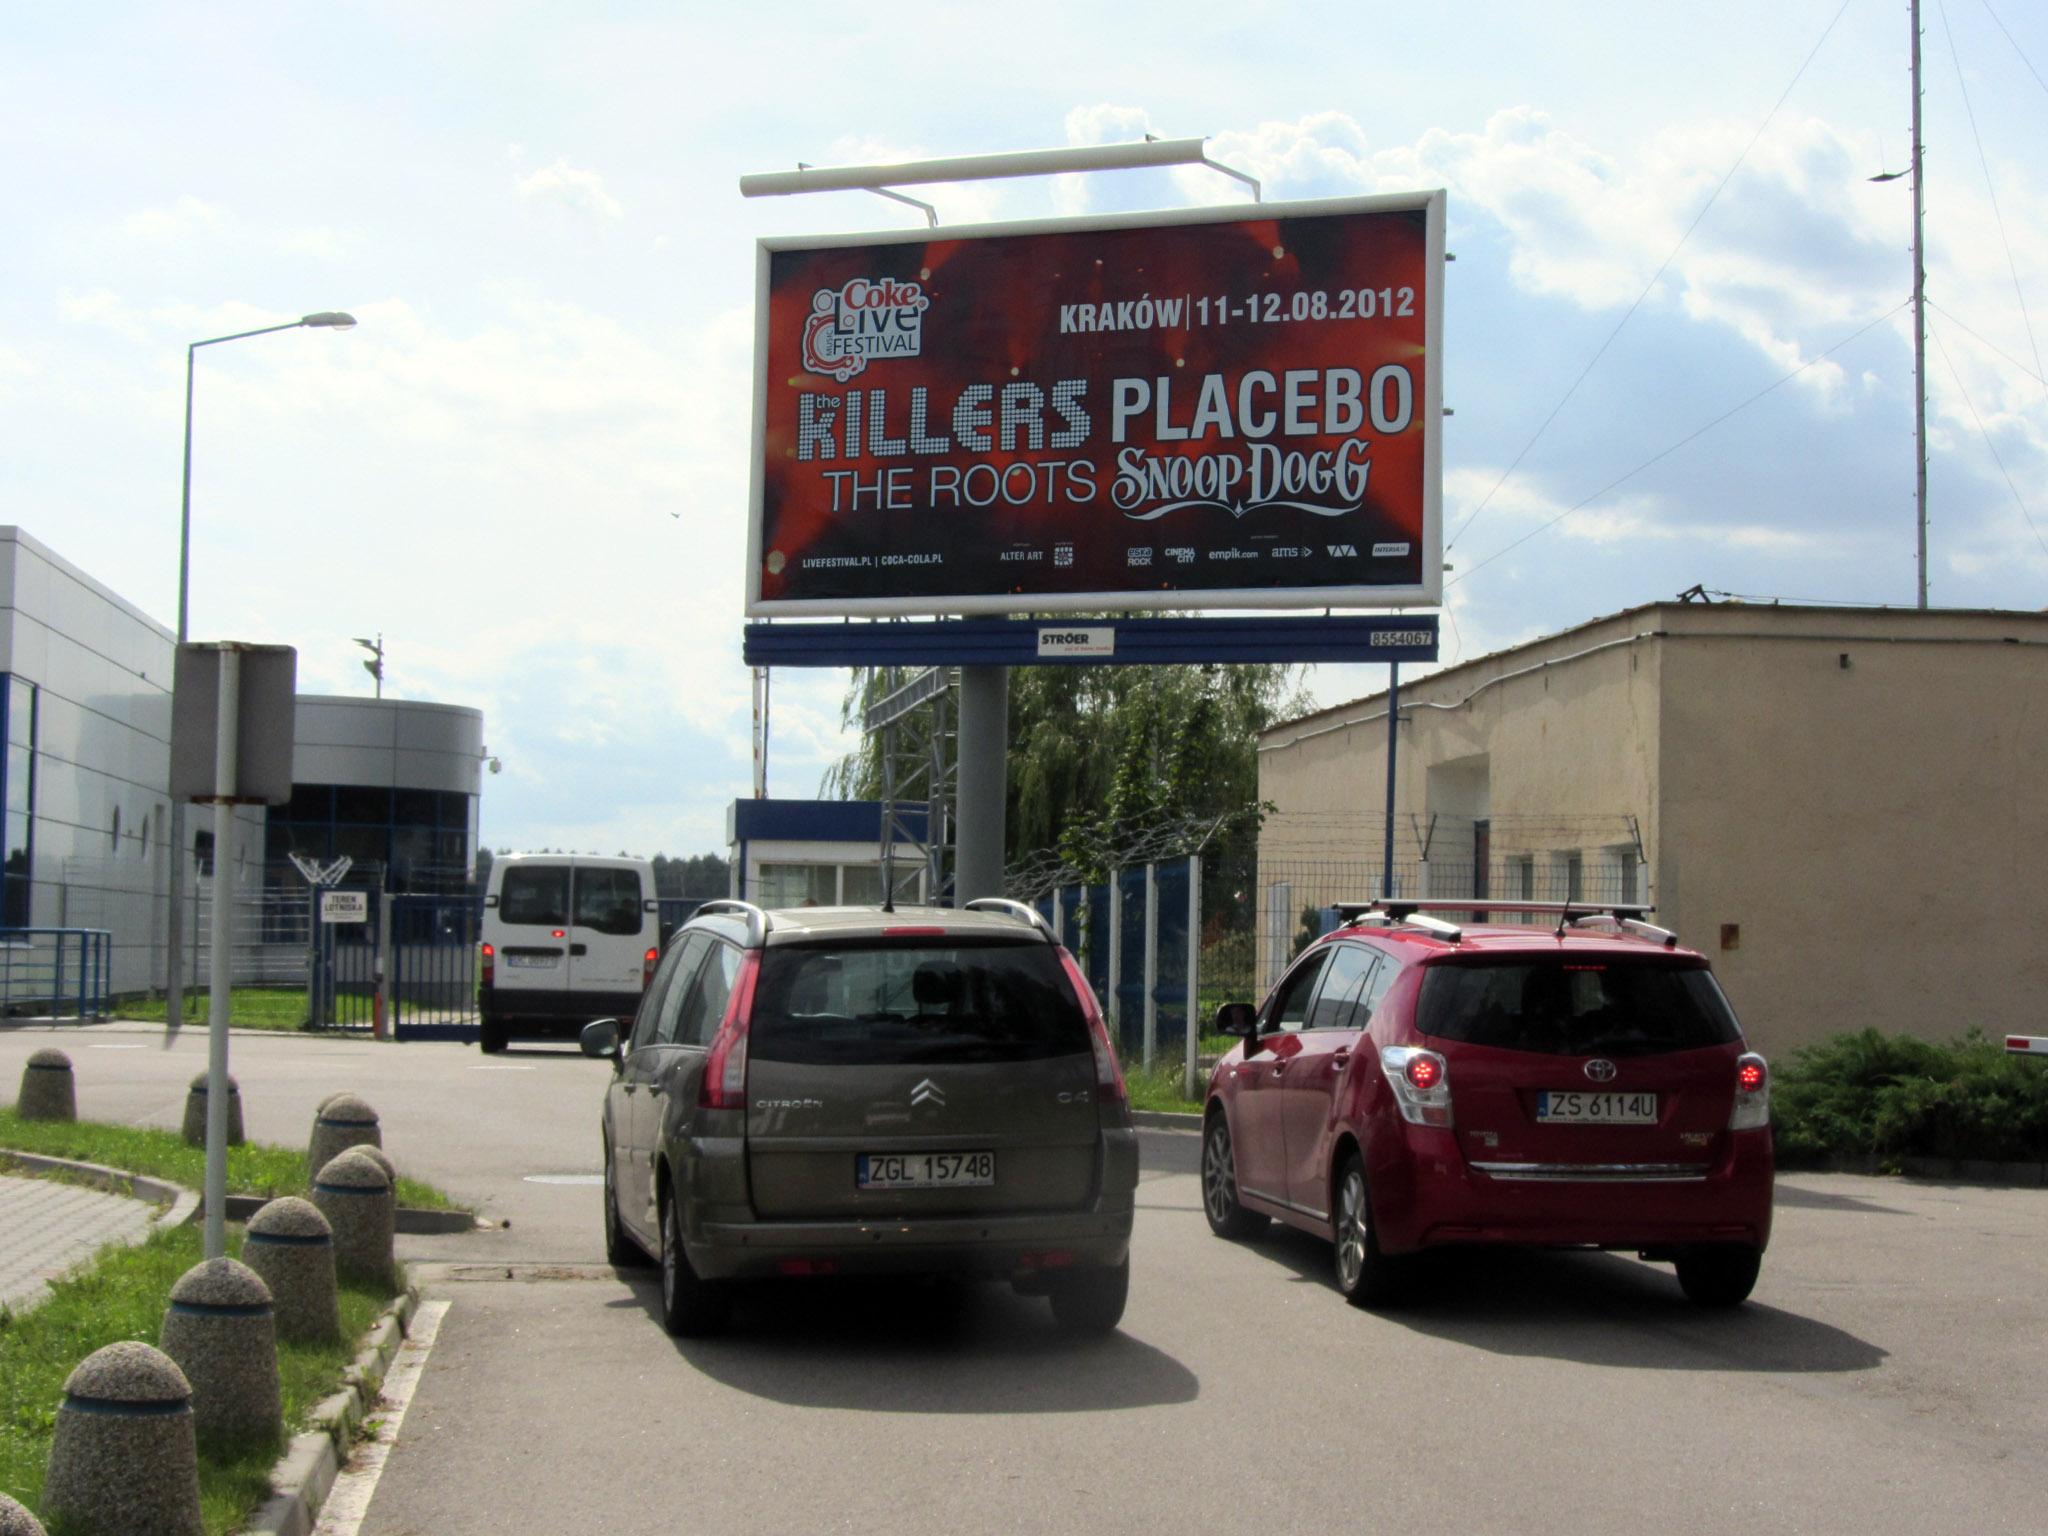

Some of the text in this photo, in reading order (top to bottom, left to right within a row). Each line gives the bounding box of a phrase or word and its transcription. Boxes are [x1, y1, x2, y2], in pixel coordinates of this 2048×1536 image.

[844, 281, 918, 310] Coke
[1060, 287, 1415, 333] KRAKÓW 11-12.08.2012
[833, 333, 918, 355] FESTIVAL
[816, 395, 841, 409] the
[1111, 364, 1413, 443] PLACEBO
[1111, 438, 1371, 510] SNOOP DOGG
[822, 460, 1097, 512] THE ROOTS
[1000, 551, 1044, 561] ALTER ART
[1208, 547, 1259, 561] empik.com
[1372, 632, 1431, 645] 8554067
[324, 903, 363, 912] LOTNISKA
[331, 895, 357, 903] TEREN
[1551, 1094, 1654, 1117] ZS 6114U
[870, 1154, 991, 1182] ZGL 15748
